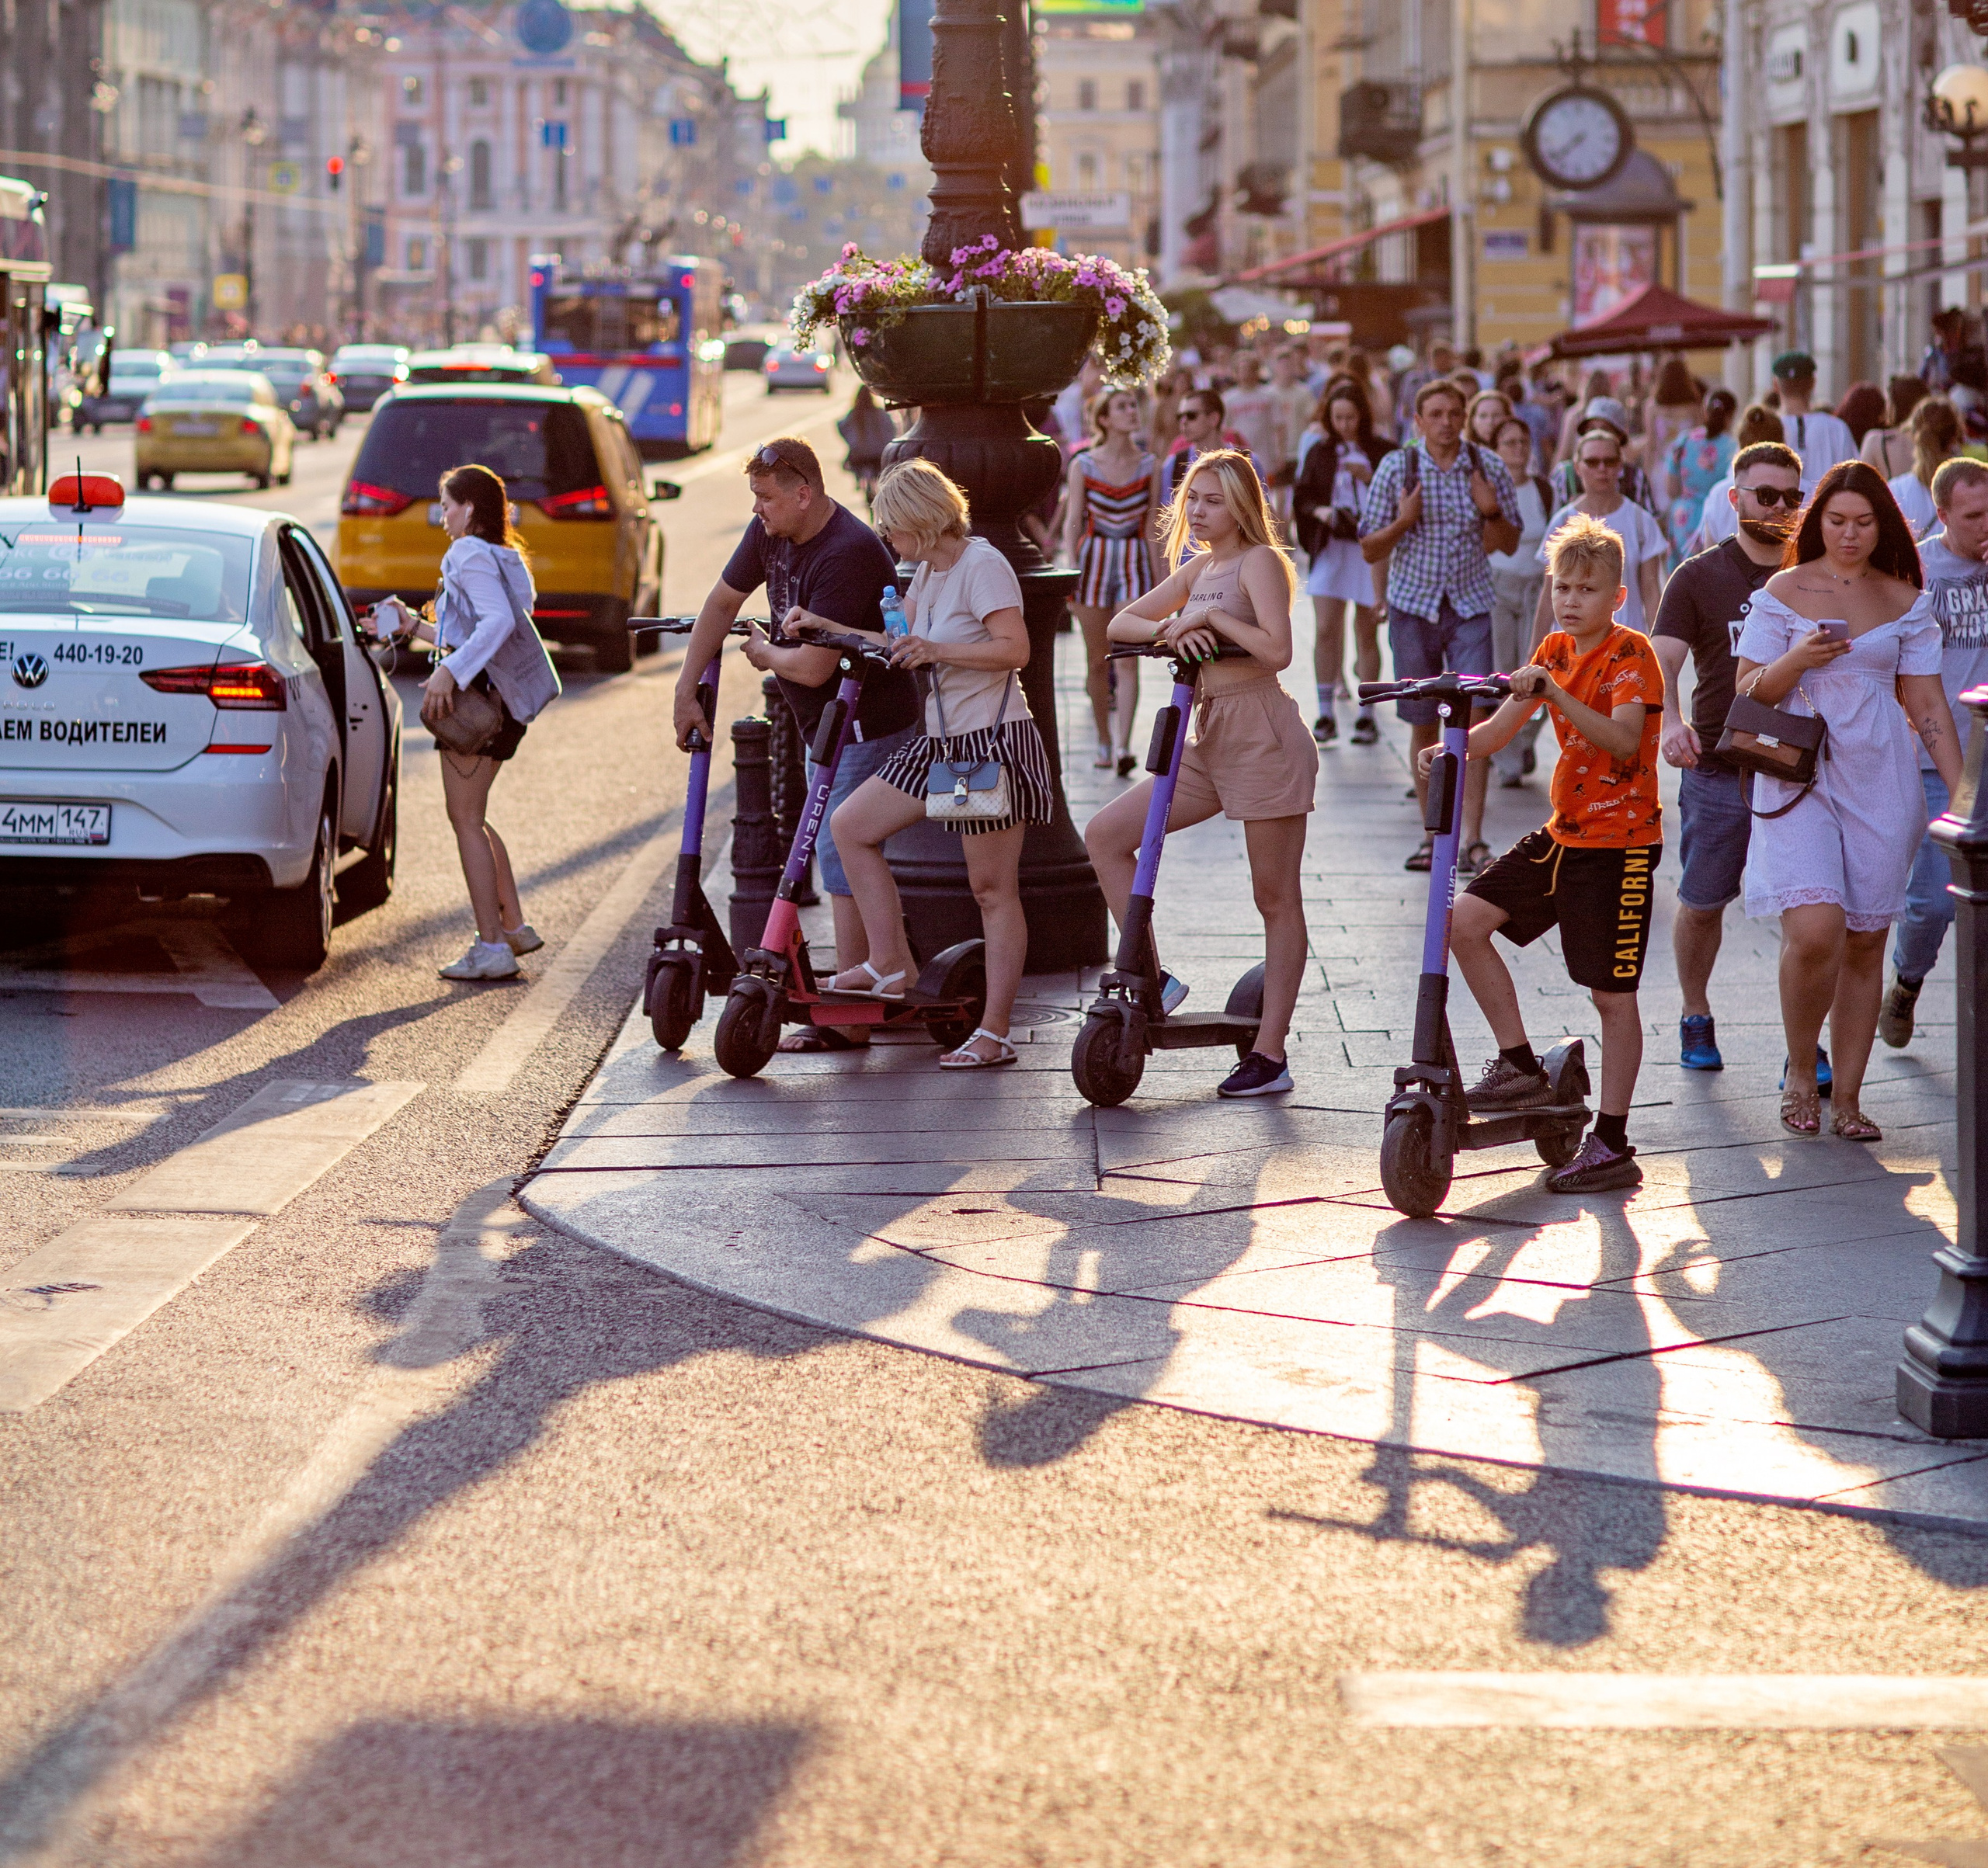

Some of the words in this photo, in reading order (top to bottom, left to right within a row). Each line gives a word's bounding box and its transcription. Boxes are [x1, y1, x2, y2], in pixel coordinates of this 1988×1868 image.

[1189, 592, 1224, 602] DARLING
[1947, 585, 1988, 614] GRA
[54, 643, 144, 665] 440-19-20
[0, 719, 33, 741] ЕМ
[61, 808, 100, 829] 147
[68, 828, 89, 838] RUS
[1613, 849, 1649, 978] CALIFORNI
